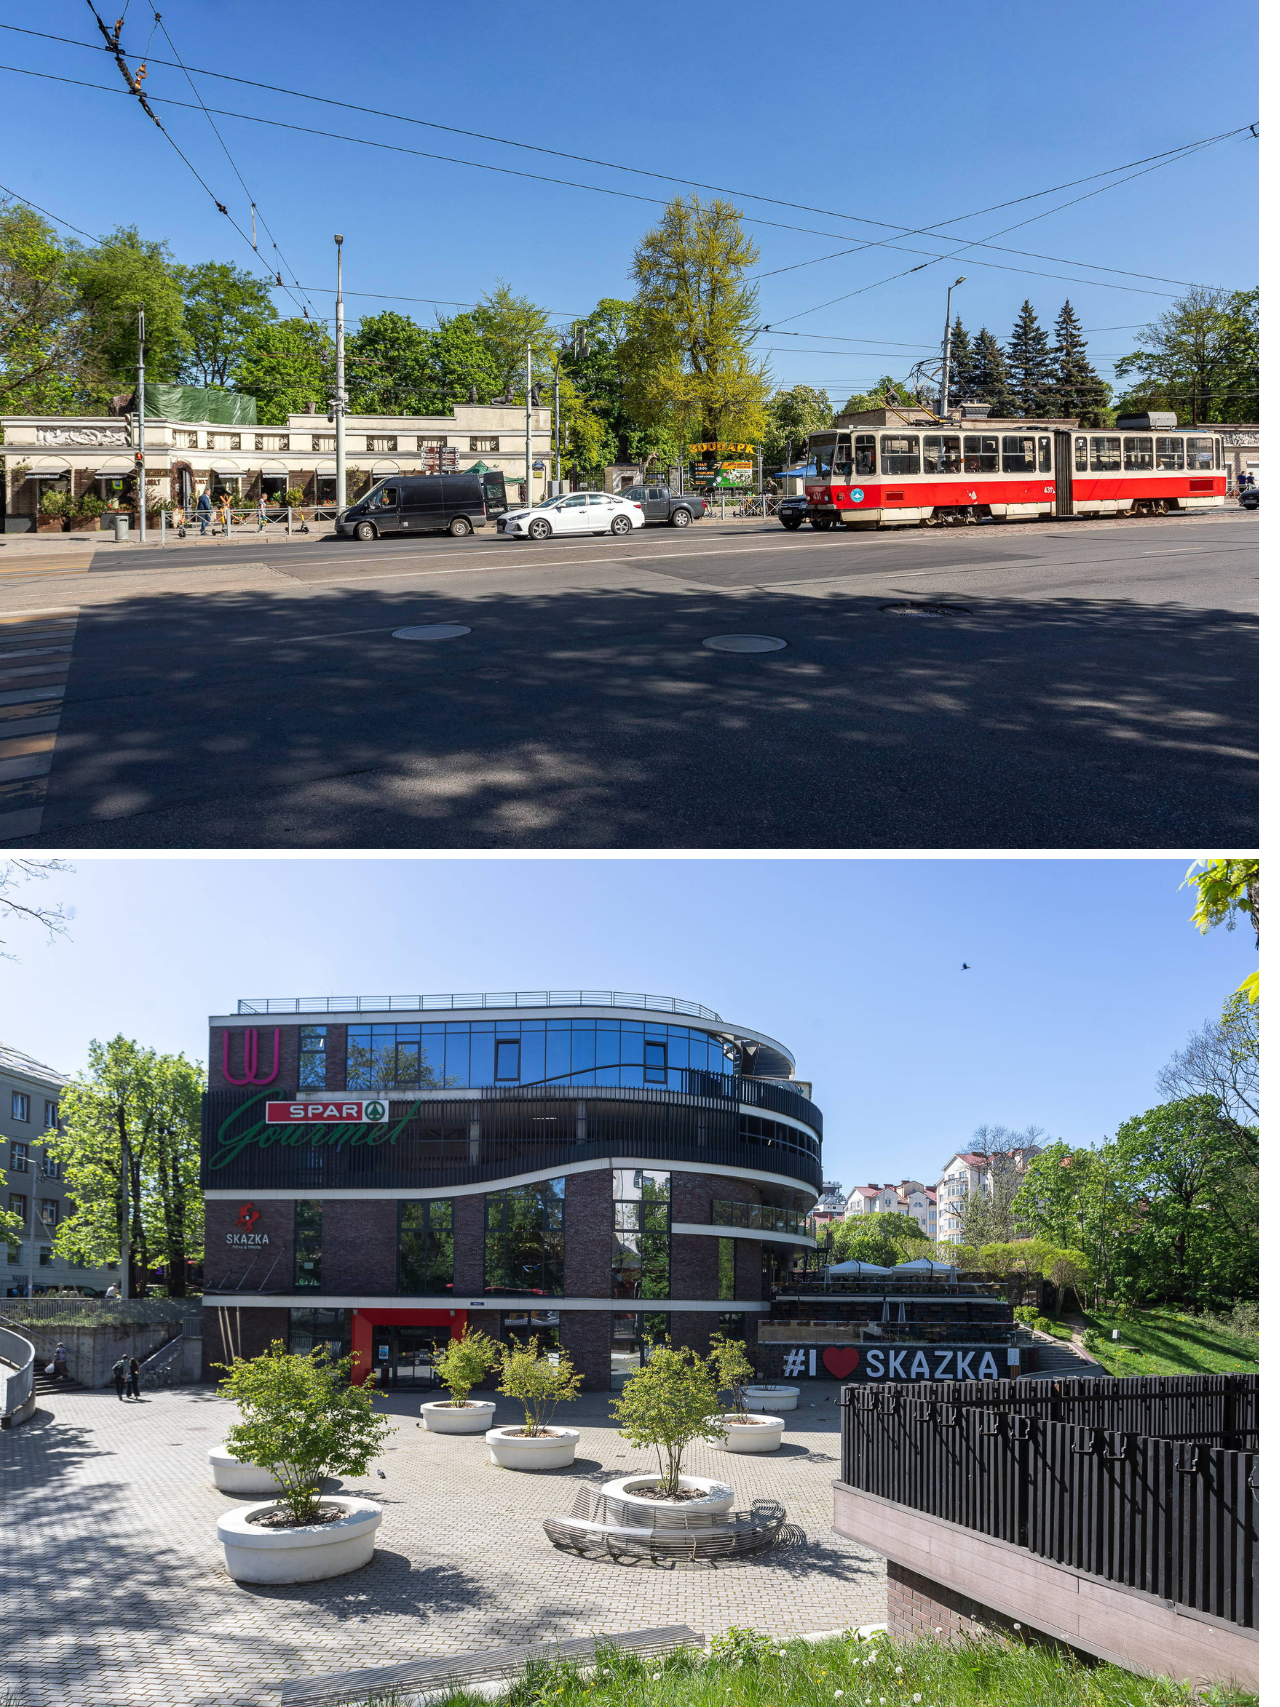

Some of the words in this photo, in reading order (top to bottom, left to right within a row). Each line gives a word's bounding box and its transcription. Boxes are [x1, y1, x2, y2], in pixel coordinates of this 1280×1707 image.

[689, 442, 755, 454] ЗООПАРК
[813, 492, 822, 501] 431
[289, 1104, 358, 1118] SPAR
[208, 1088, 422, 1170] Gourmet
[226, 1233, 269, 1245] SKAZKA
[866, 1349, 998, 1380] SKAZKA
